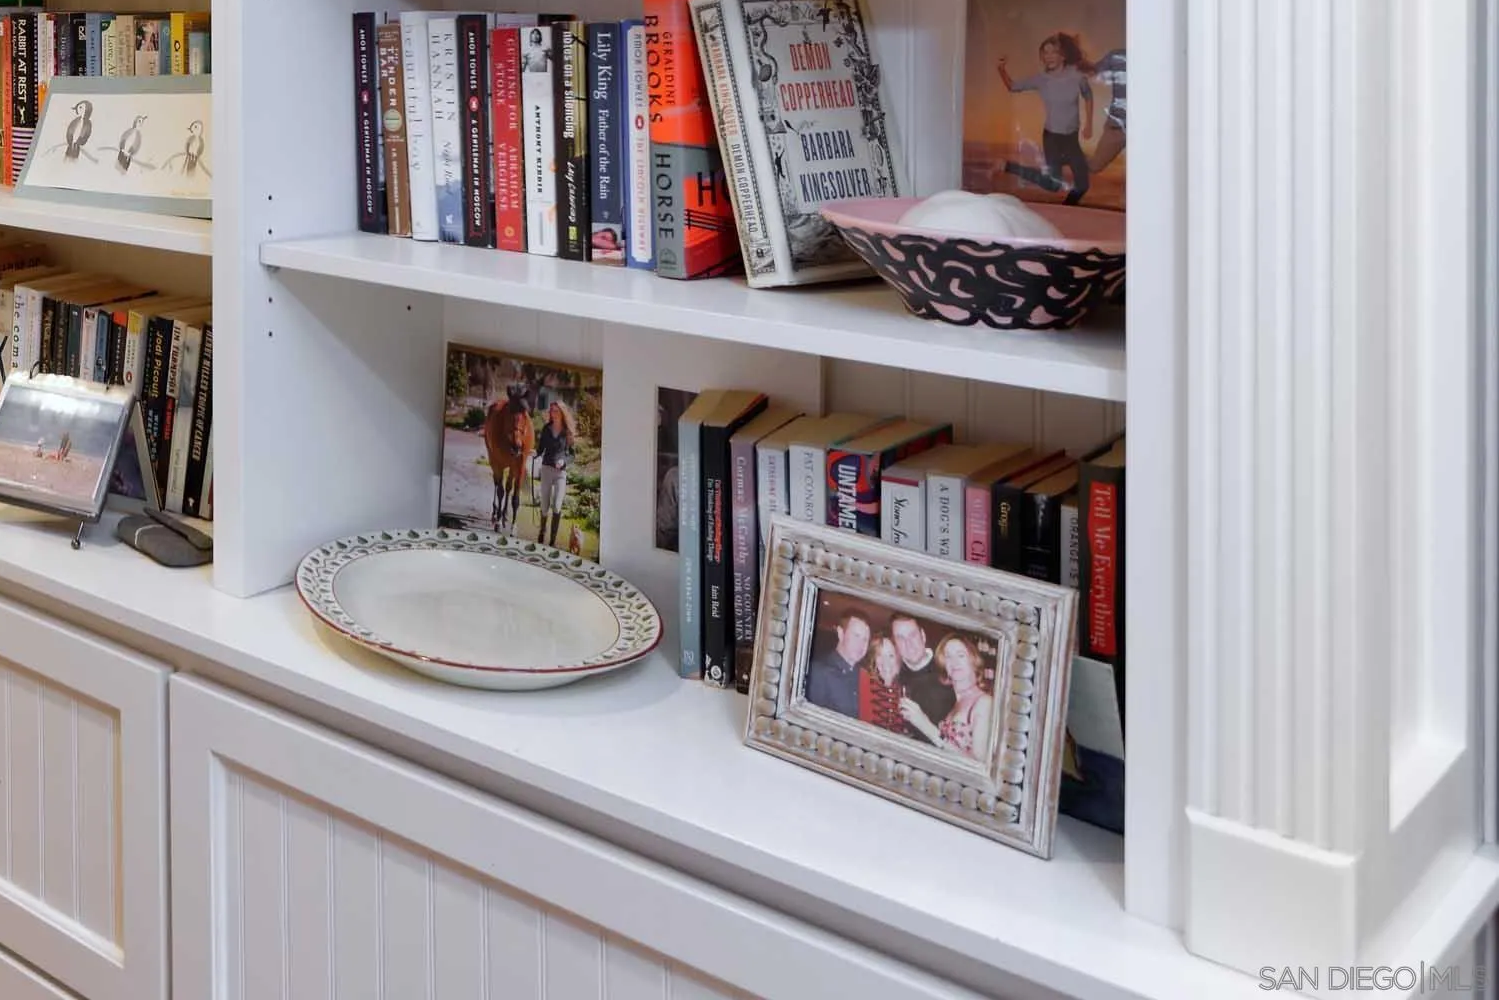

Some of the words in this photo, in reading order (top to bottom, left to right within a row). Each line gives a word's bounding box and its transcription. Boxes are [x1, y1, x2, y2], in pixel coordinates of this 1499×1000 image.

[17, 19, 27, 57] RABBIT
[359, 28, 367, 50] AMOR
[468, 31, 477, 54] AMOR
[564, 31, 575, 61] notes
[593, 32, 610, 61] Lily
[17, 58, 26, 74] AT
[380, 47, 389, 78] BAR
[469, 57, 478, 88] TOWLES
[506, 38, 518, 99] CUTTING
[564, 64, 575, 78] on
[644, 15, 663, 124] BROOKS
[662, 31, 675, 106] GERALDINE
[790, 43, 831, 72] DEMON
[18, 76, 27, 103] REST
[431, 33, 443, 120] HANNAH
[443, 33, 456, 121] KRISTIN
[496, 62, 506, 105] STONE
[593, 65, 611, 100] King
[779, 78, 855, 112] COPPERHEAD
[506, 104, 518, 131] FOR
[563, 89, 575, 138] silencing
[598, 109, 609, 142] Father
[363, 119, 371, 164] GENTLEMAN
[471, 128, 479, 174] GENTLEMAN
[598, 143, 609, 155] of
[801, 129, 855, 162] BARBARA
[365, 166, 371, 175] IN
[497, 142, 509, 211] VERGHESE
[508, 144, 519, 209] ABRAHAM
[598, 156, 610, 173] the
[365, 177, 373, 214] MOSCOW
[472, 177, 479, 186] IN
[598, 176, 610, 199] Rain
[654, 152, 674, 240] HORSE
[800, 167, 872, 202] KINGSOLVER
[472, 188, 481, 227] MOSCOW
[154, 331, 164, 356] Jodi
[172, 325, 182, 342] JIM
[151, 358, 162, 398] Picoult
[169, 345, 180, 394] THOMPSON
[199, 360, 211, 391] MILLER
[197, 391, 207, 417] TROPIC
[196, 418, 205, 428] OF
[192, 428, 204, 462] CANCER
[737, 456, 747, 502] Cormac
[1093, 486, 1111, 518] Tell
[736, 504, 749, 566] McCarthy
[1095, 526, 1111, 551] Me
[711, 585, 720, 600] Iain
[734, 571, 742, 592] FOR
[744, 574, 751, 590] NO
[712, 602, 720, 618] Reid
[734, 594, 743, 616] OLD
[1090, 553, 1112, 648] Everything
[735, 618, 744, 642] MEN
[744, 593, 754, 642] COUNTRY
